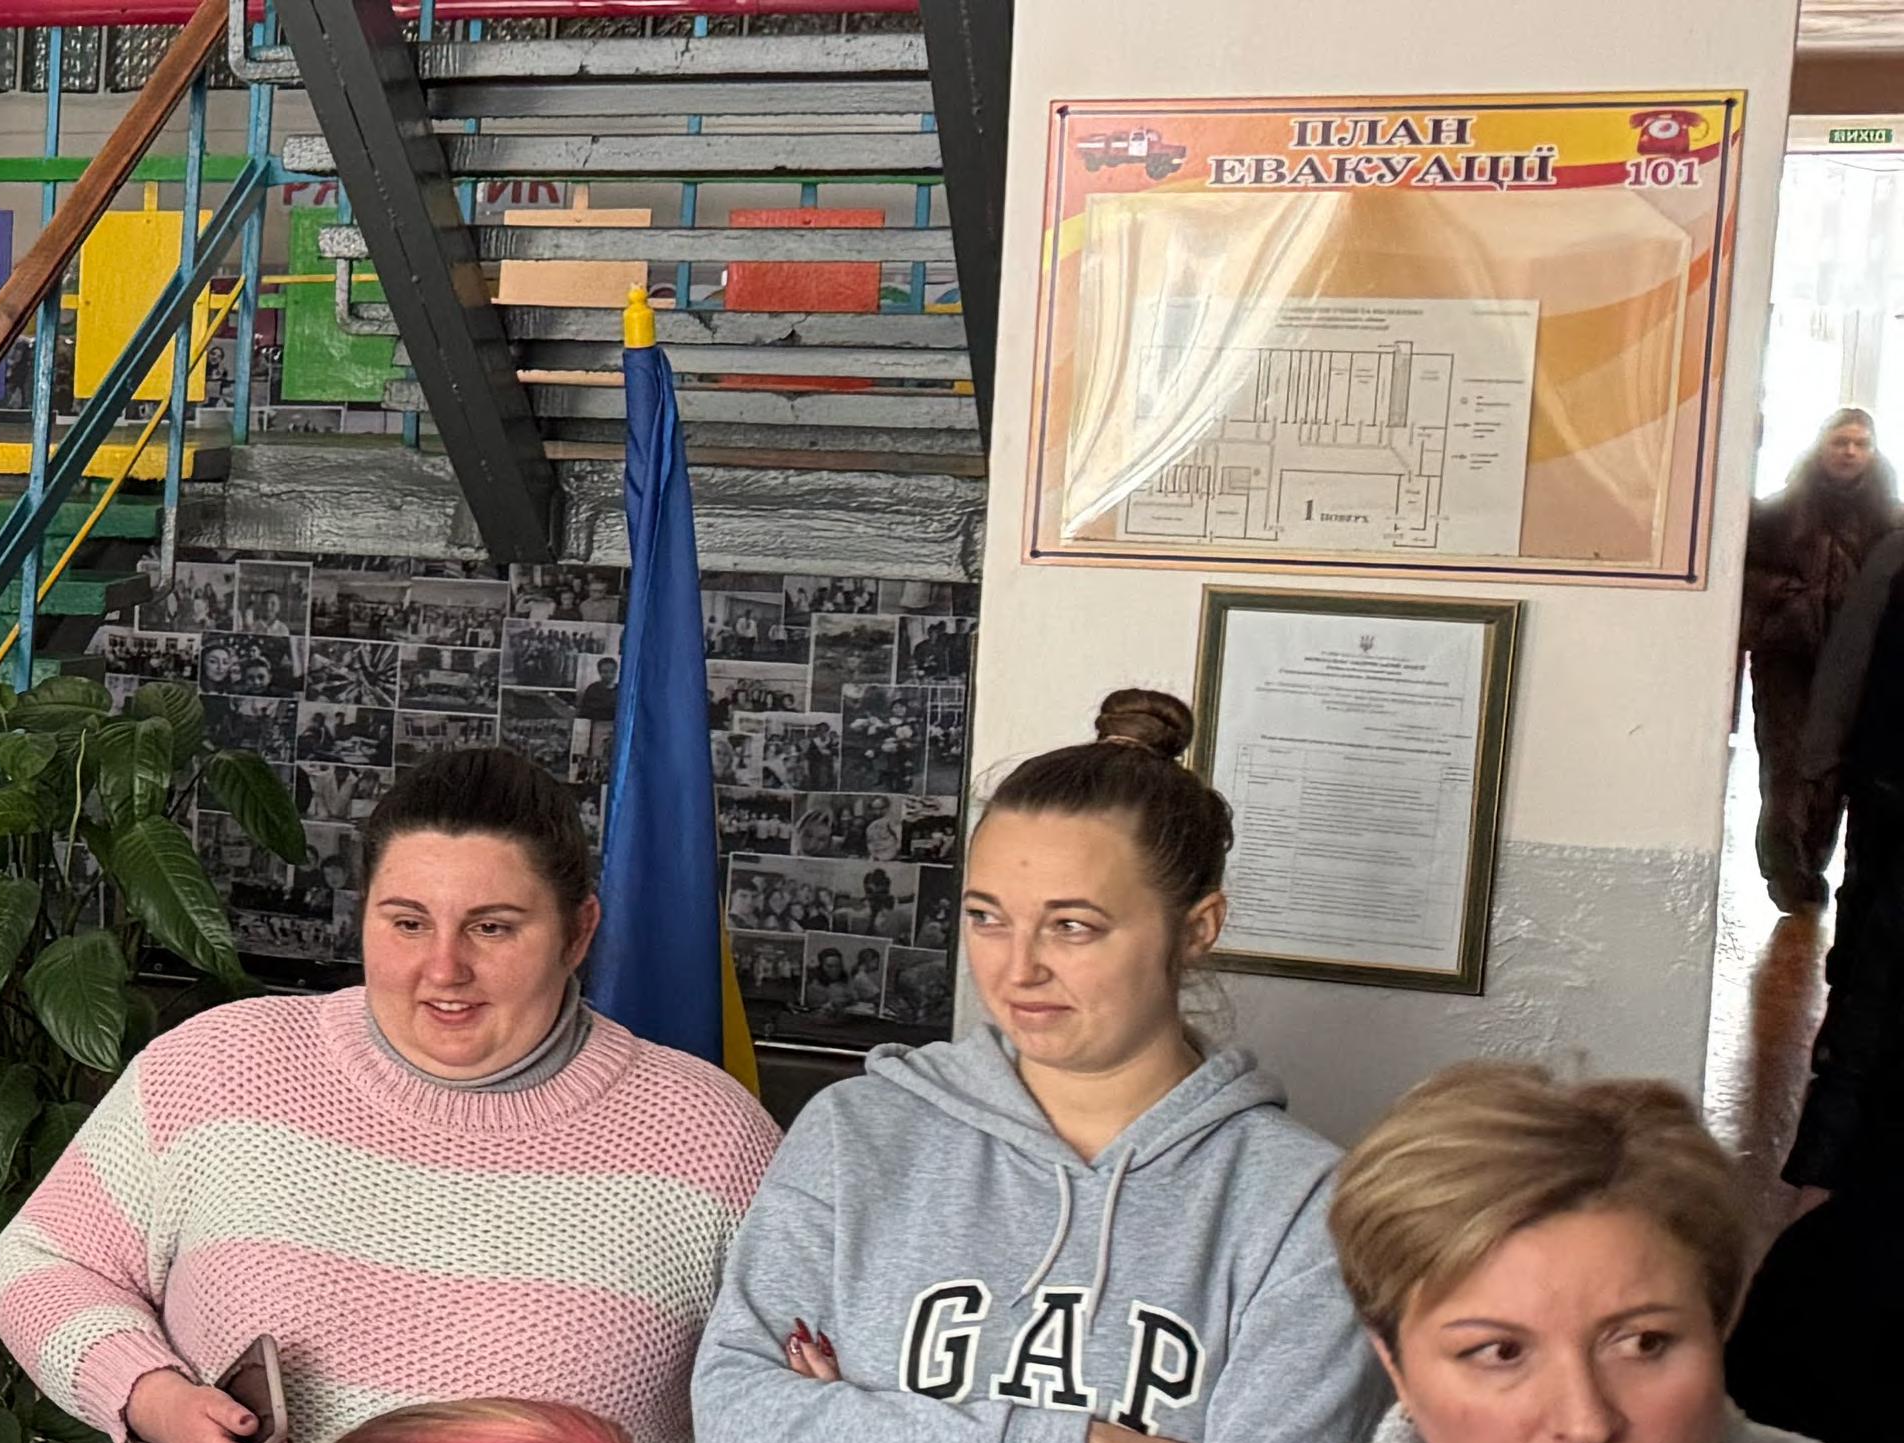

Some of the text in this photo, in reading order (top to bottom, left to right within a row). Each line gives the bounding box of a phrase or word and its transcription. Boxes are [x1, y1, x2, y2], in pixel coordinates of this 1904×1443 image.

[1292, 116, 1472, 148] ПЛАН
[1209, 147, 1555, 189] ЕВАКУАЦІЇ
[1626, 158, 1704, 186] 101
[900, 1280, 1205, 1436] GAP
